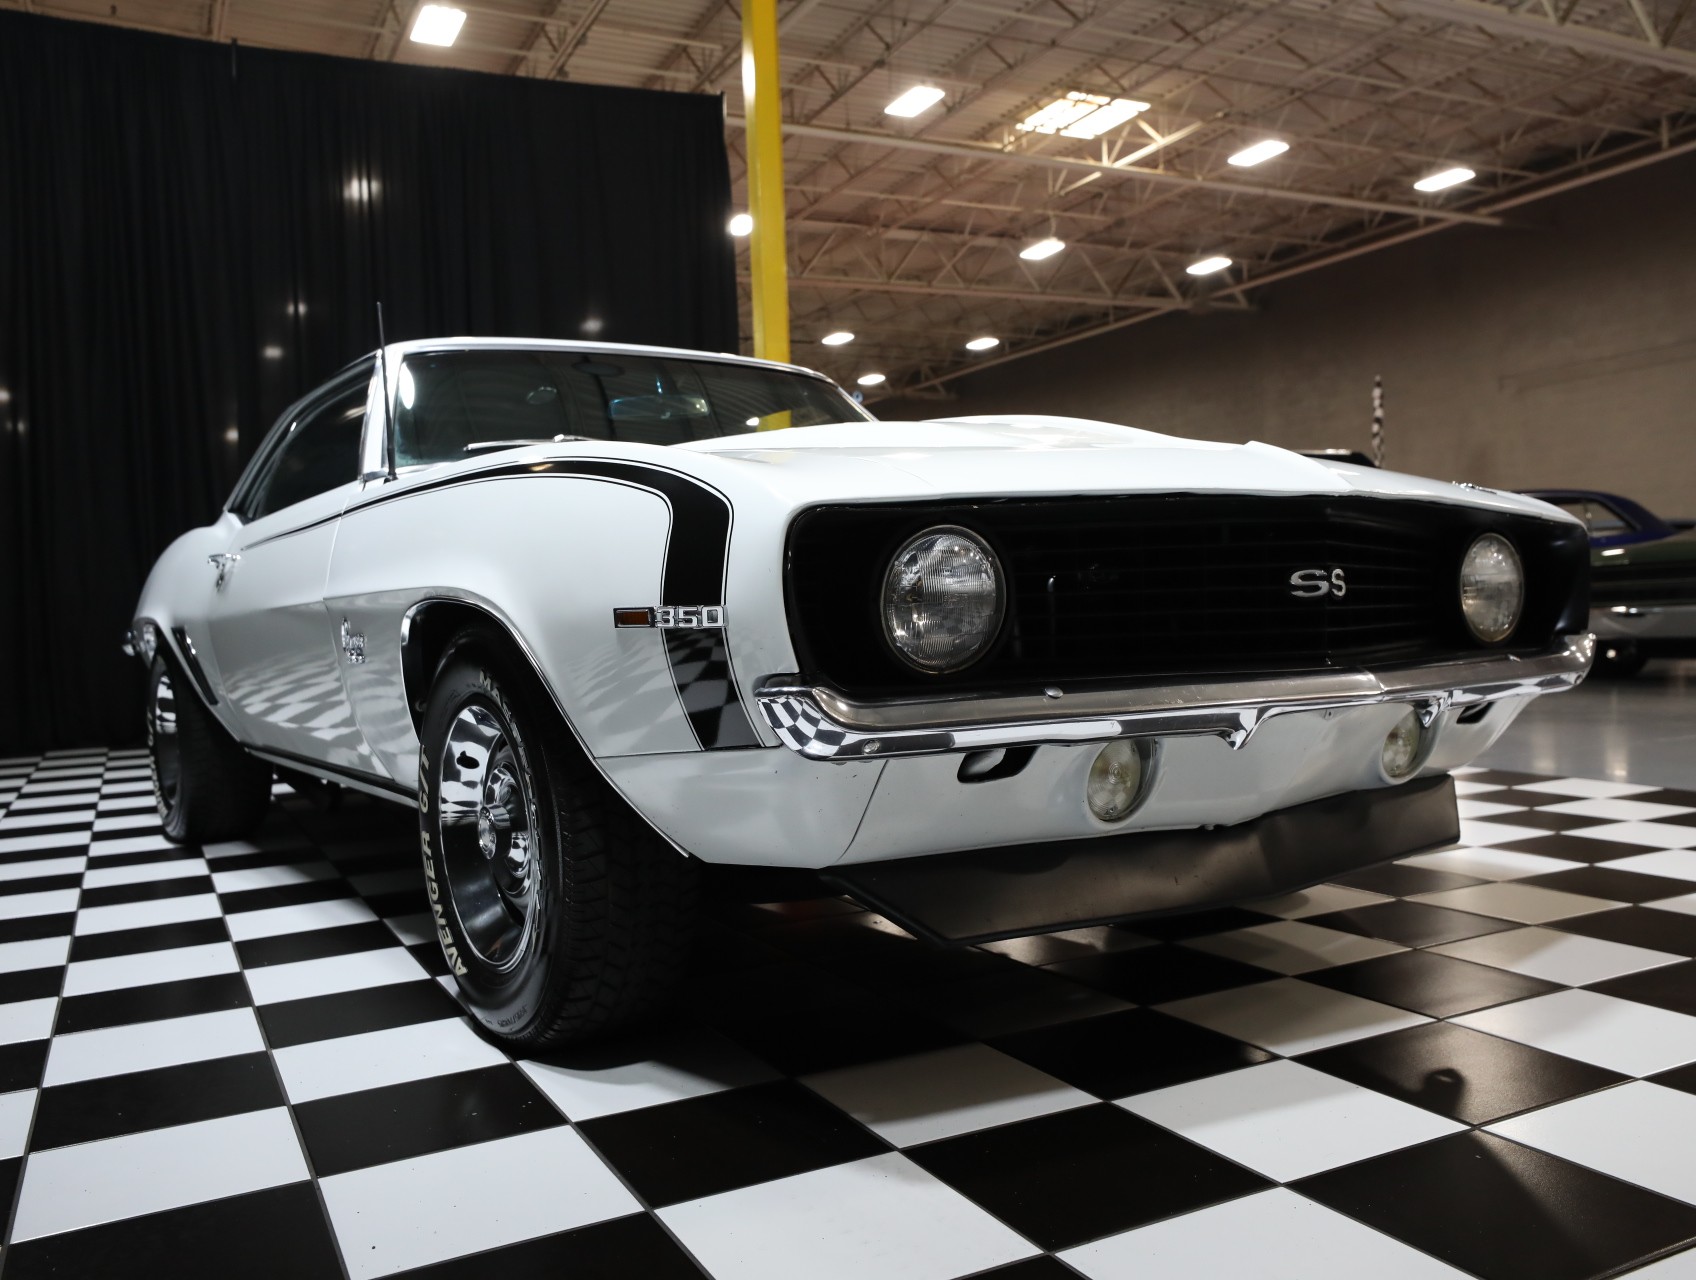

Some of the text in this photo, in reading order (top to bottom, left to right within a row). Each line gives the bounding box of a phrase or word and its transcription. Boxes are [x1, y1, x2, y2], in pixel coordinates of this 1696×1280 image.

[1290, 568, 1346, 597] SS
[656, 605, 726, 628] 350
[421, 830, 468, 977] AVENGER
